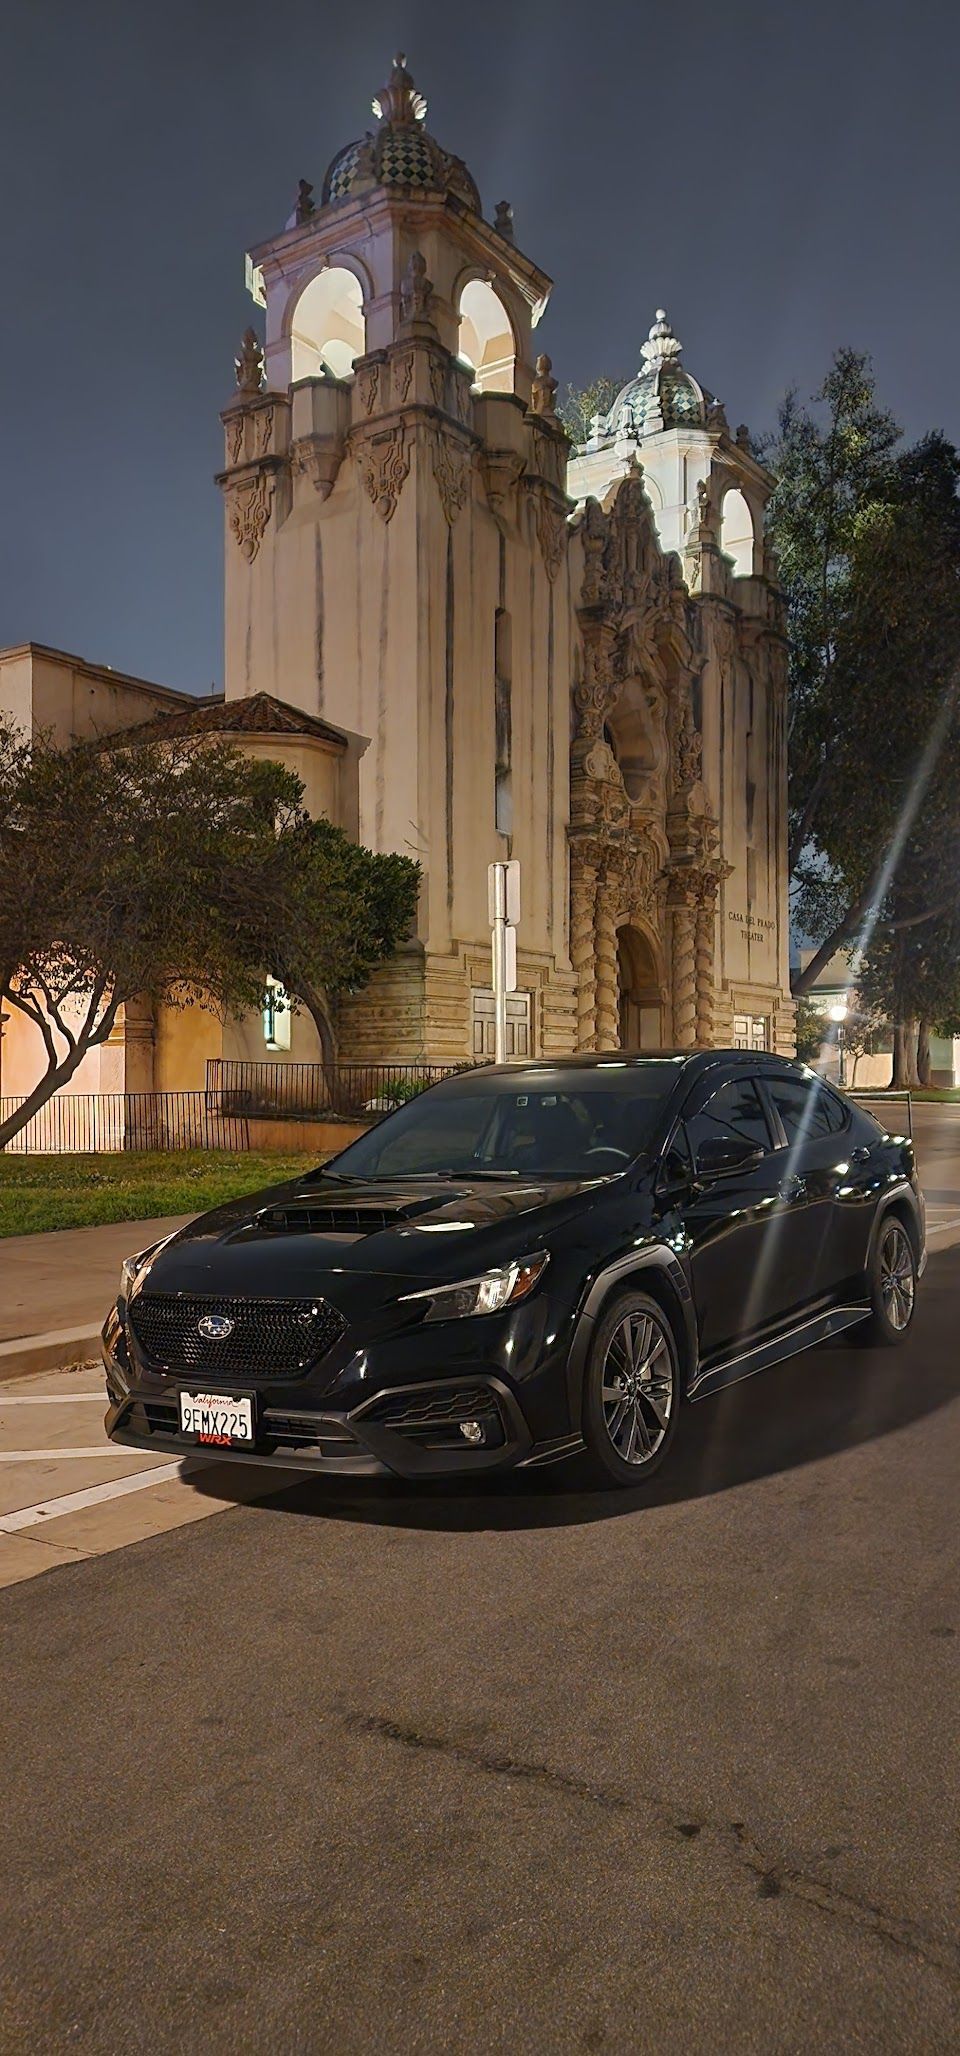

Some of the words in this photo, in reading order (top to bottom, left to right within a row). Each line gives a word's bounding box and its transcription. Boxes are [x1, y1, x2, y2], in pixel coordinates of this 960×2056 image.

[728, 911, 744, 923] CASA
[745, 915, 755, 926] DEL
[757, 918, 776, 930] PRADO
[741, 930, 764, 943] THEATER
[192, 1394, 238, 1408] California
[183, 1408, 248, 1438] 9EMX225
[199, 1433, 232, 1446] WRX
